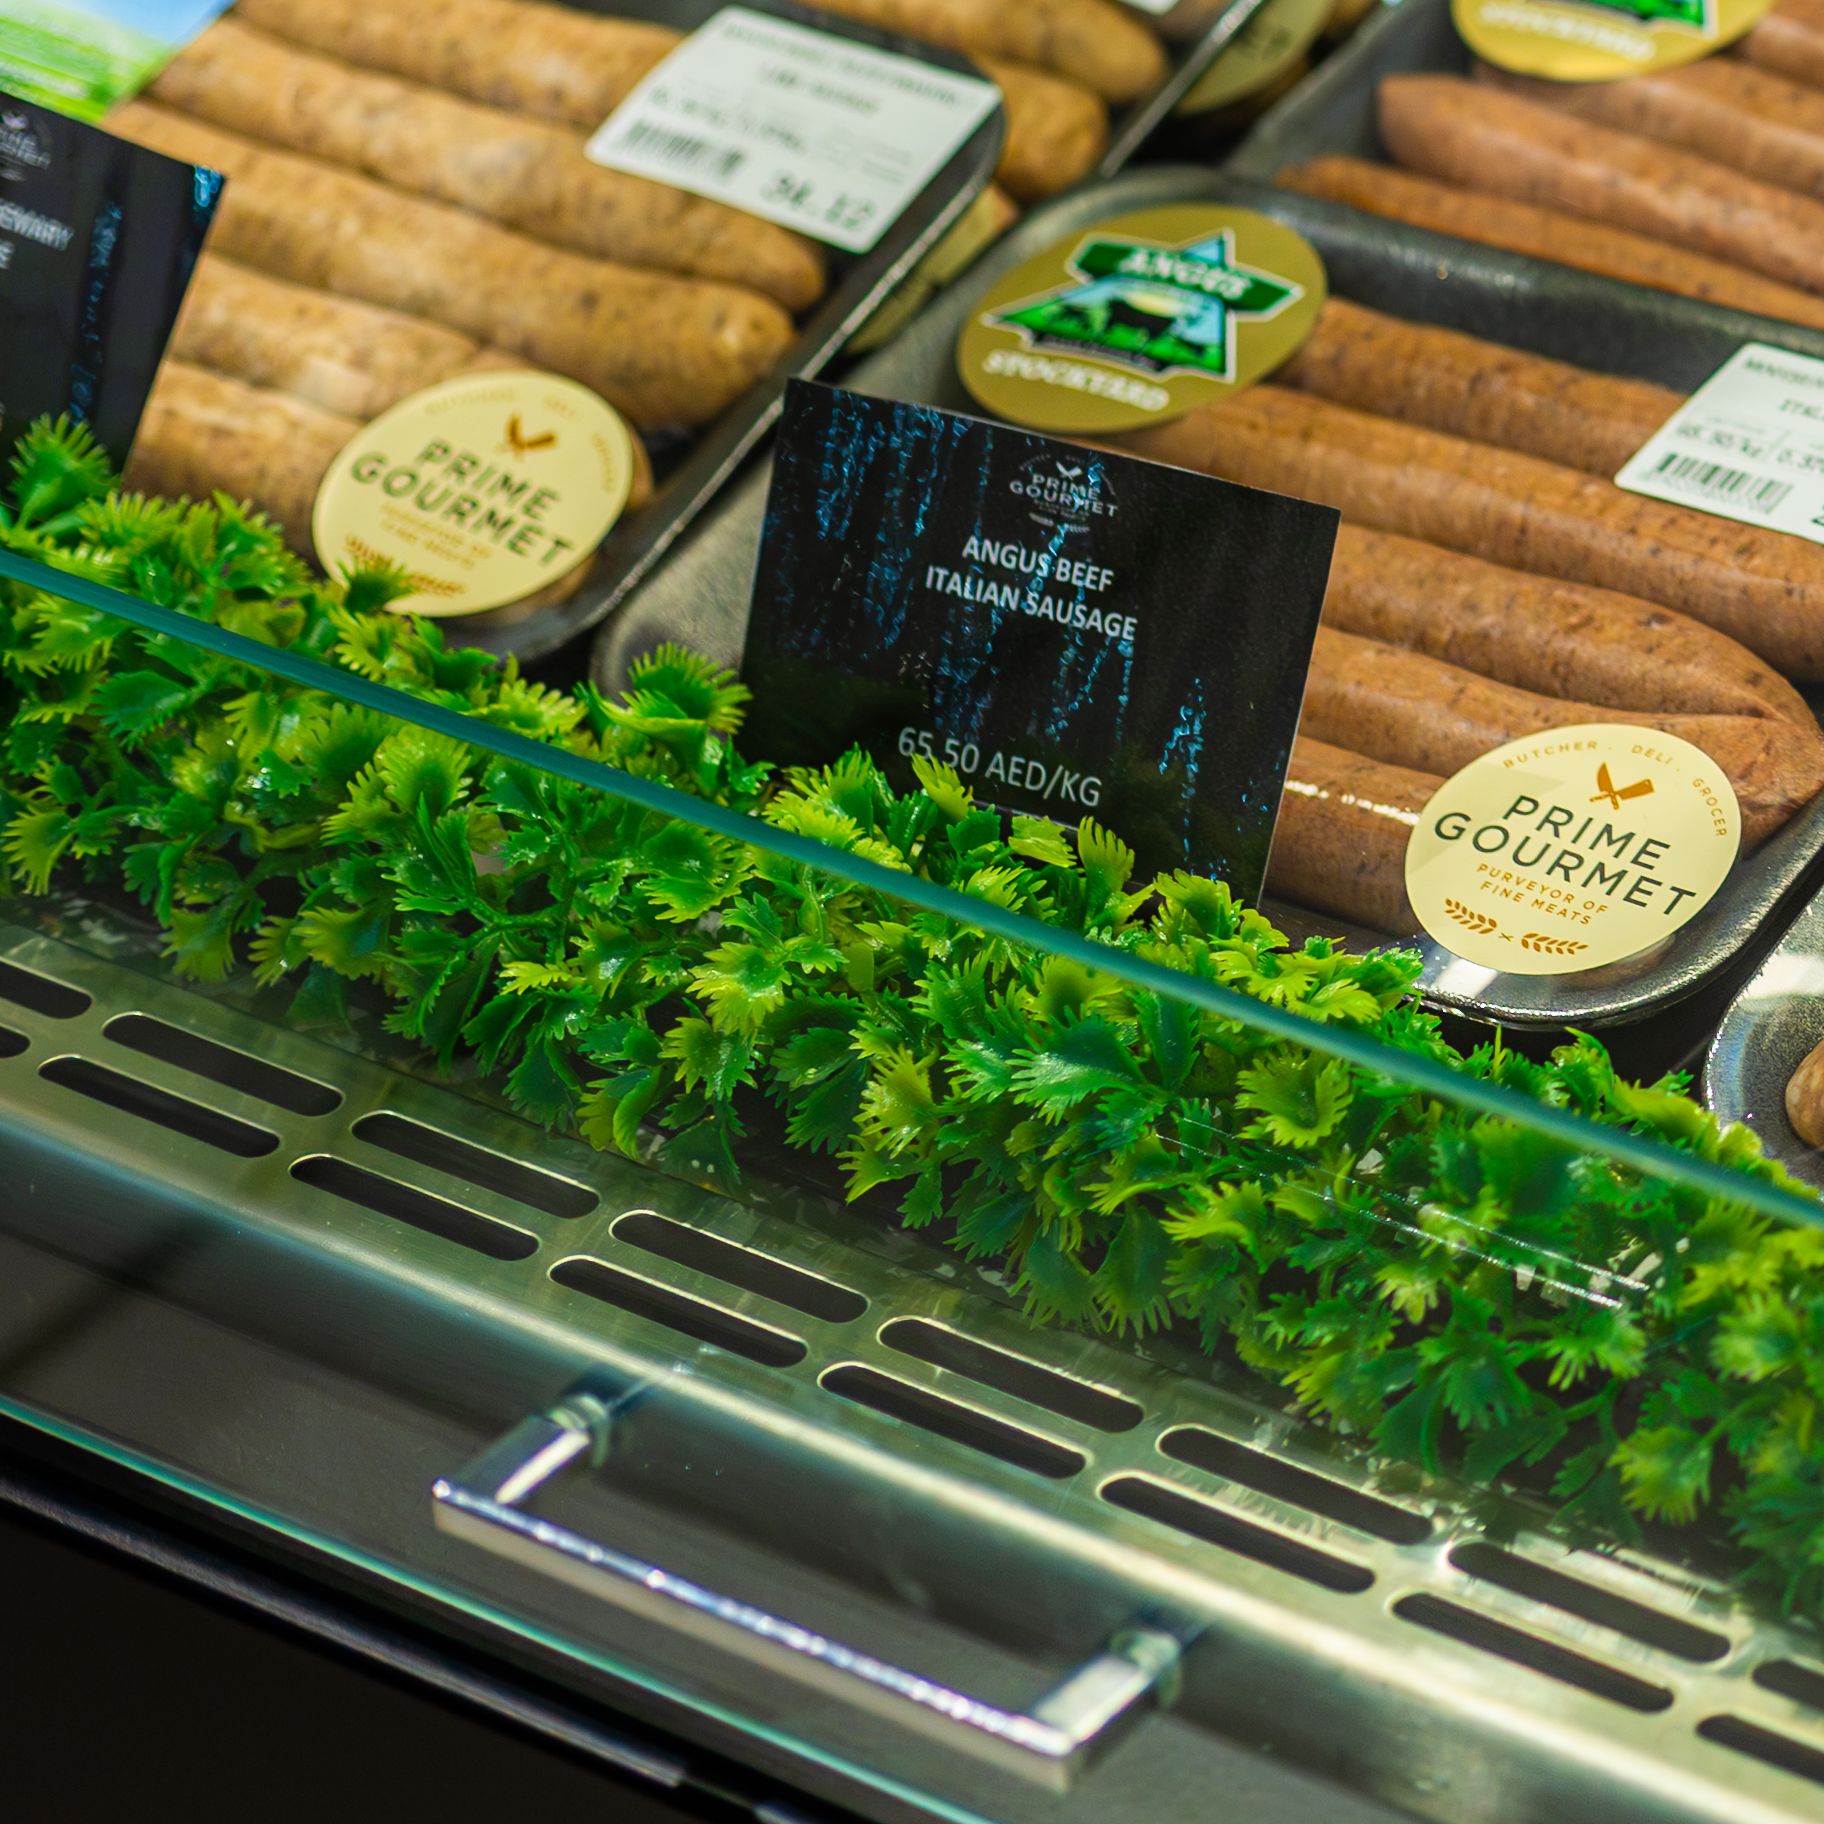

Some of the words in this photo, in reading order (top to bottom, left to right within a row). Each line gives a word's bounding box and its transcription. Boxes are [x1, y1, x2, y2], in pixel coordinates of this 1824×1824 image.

[351, 451, 576, 567] GOURMET
[415, 437, 563, 521] PRIME
[1032, 473, 1101, 500] PRIME
[961, 535, 1052, 578] ANGUS
[1055, 557, 1114, 592] BEEF
[926, 566, 1019, 612] ITALIAN
[1025, 592, 1138, 641] SAUSAGE
[898, 725, 979, 773] 6550
[985, 752, 1101, 807] AED/KG
[1503, 740, 1599, 769] BUTCHER
[1631, 745, 1674, 766] DELI
[1502, 795, 1671, 870] PRIME
[1692, 778, 1728, 838] GROCER
[1434, 811, 1697, 916] GOURMET
[1477, 863, 1576, 905] PURVEYOR
[1584, 898, 1609, 915] OF
[1480, 881, 1523, 903] FINE
[1532, 898, 1593, 925] MEATS
